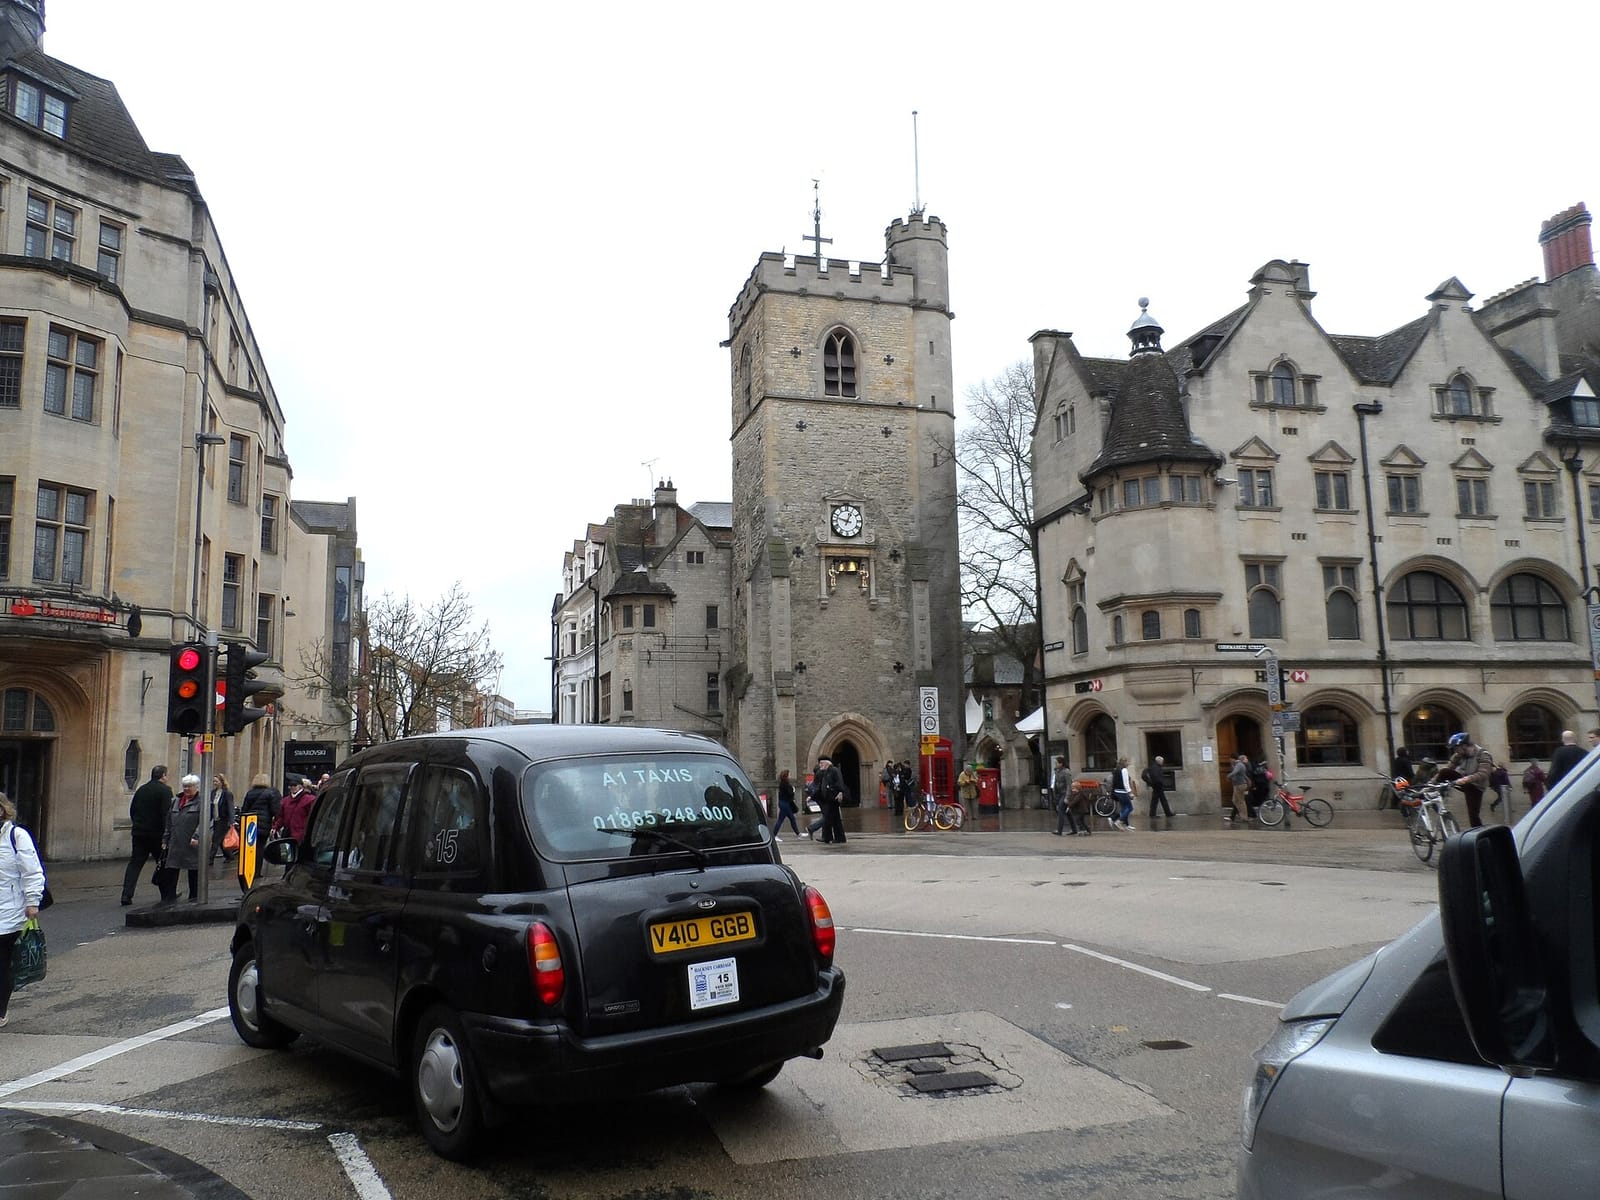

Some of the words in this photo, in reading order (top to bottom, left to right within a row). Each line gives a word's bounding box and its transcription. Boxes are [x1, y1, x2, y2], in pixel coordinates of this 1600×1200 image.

[603, 771, 628, 787] A1
[633, 768, 694, 784] TAXIS
[593, 811, 656, 830] 01865
[662, 806, 697, 824] 248
[702, 805, 734, 821] 000
[436, 829, 459, 864] 15
[652, 922, 700, 948] V410
[710, 915, 750, 939] GGB
[717, 973, 730, 984] 15
